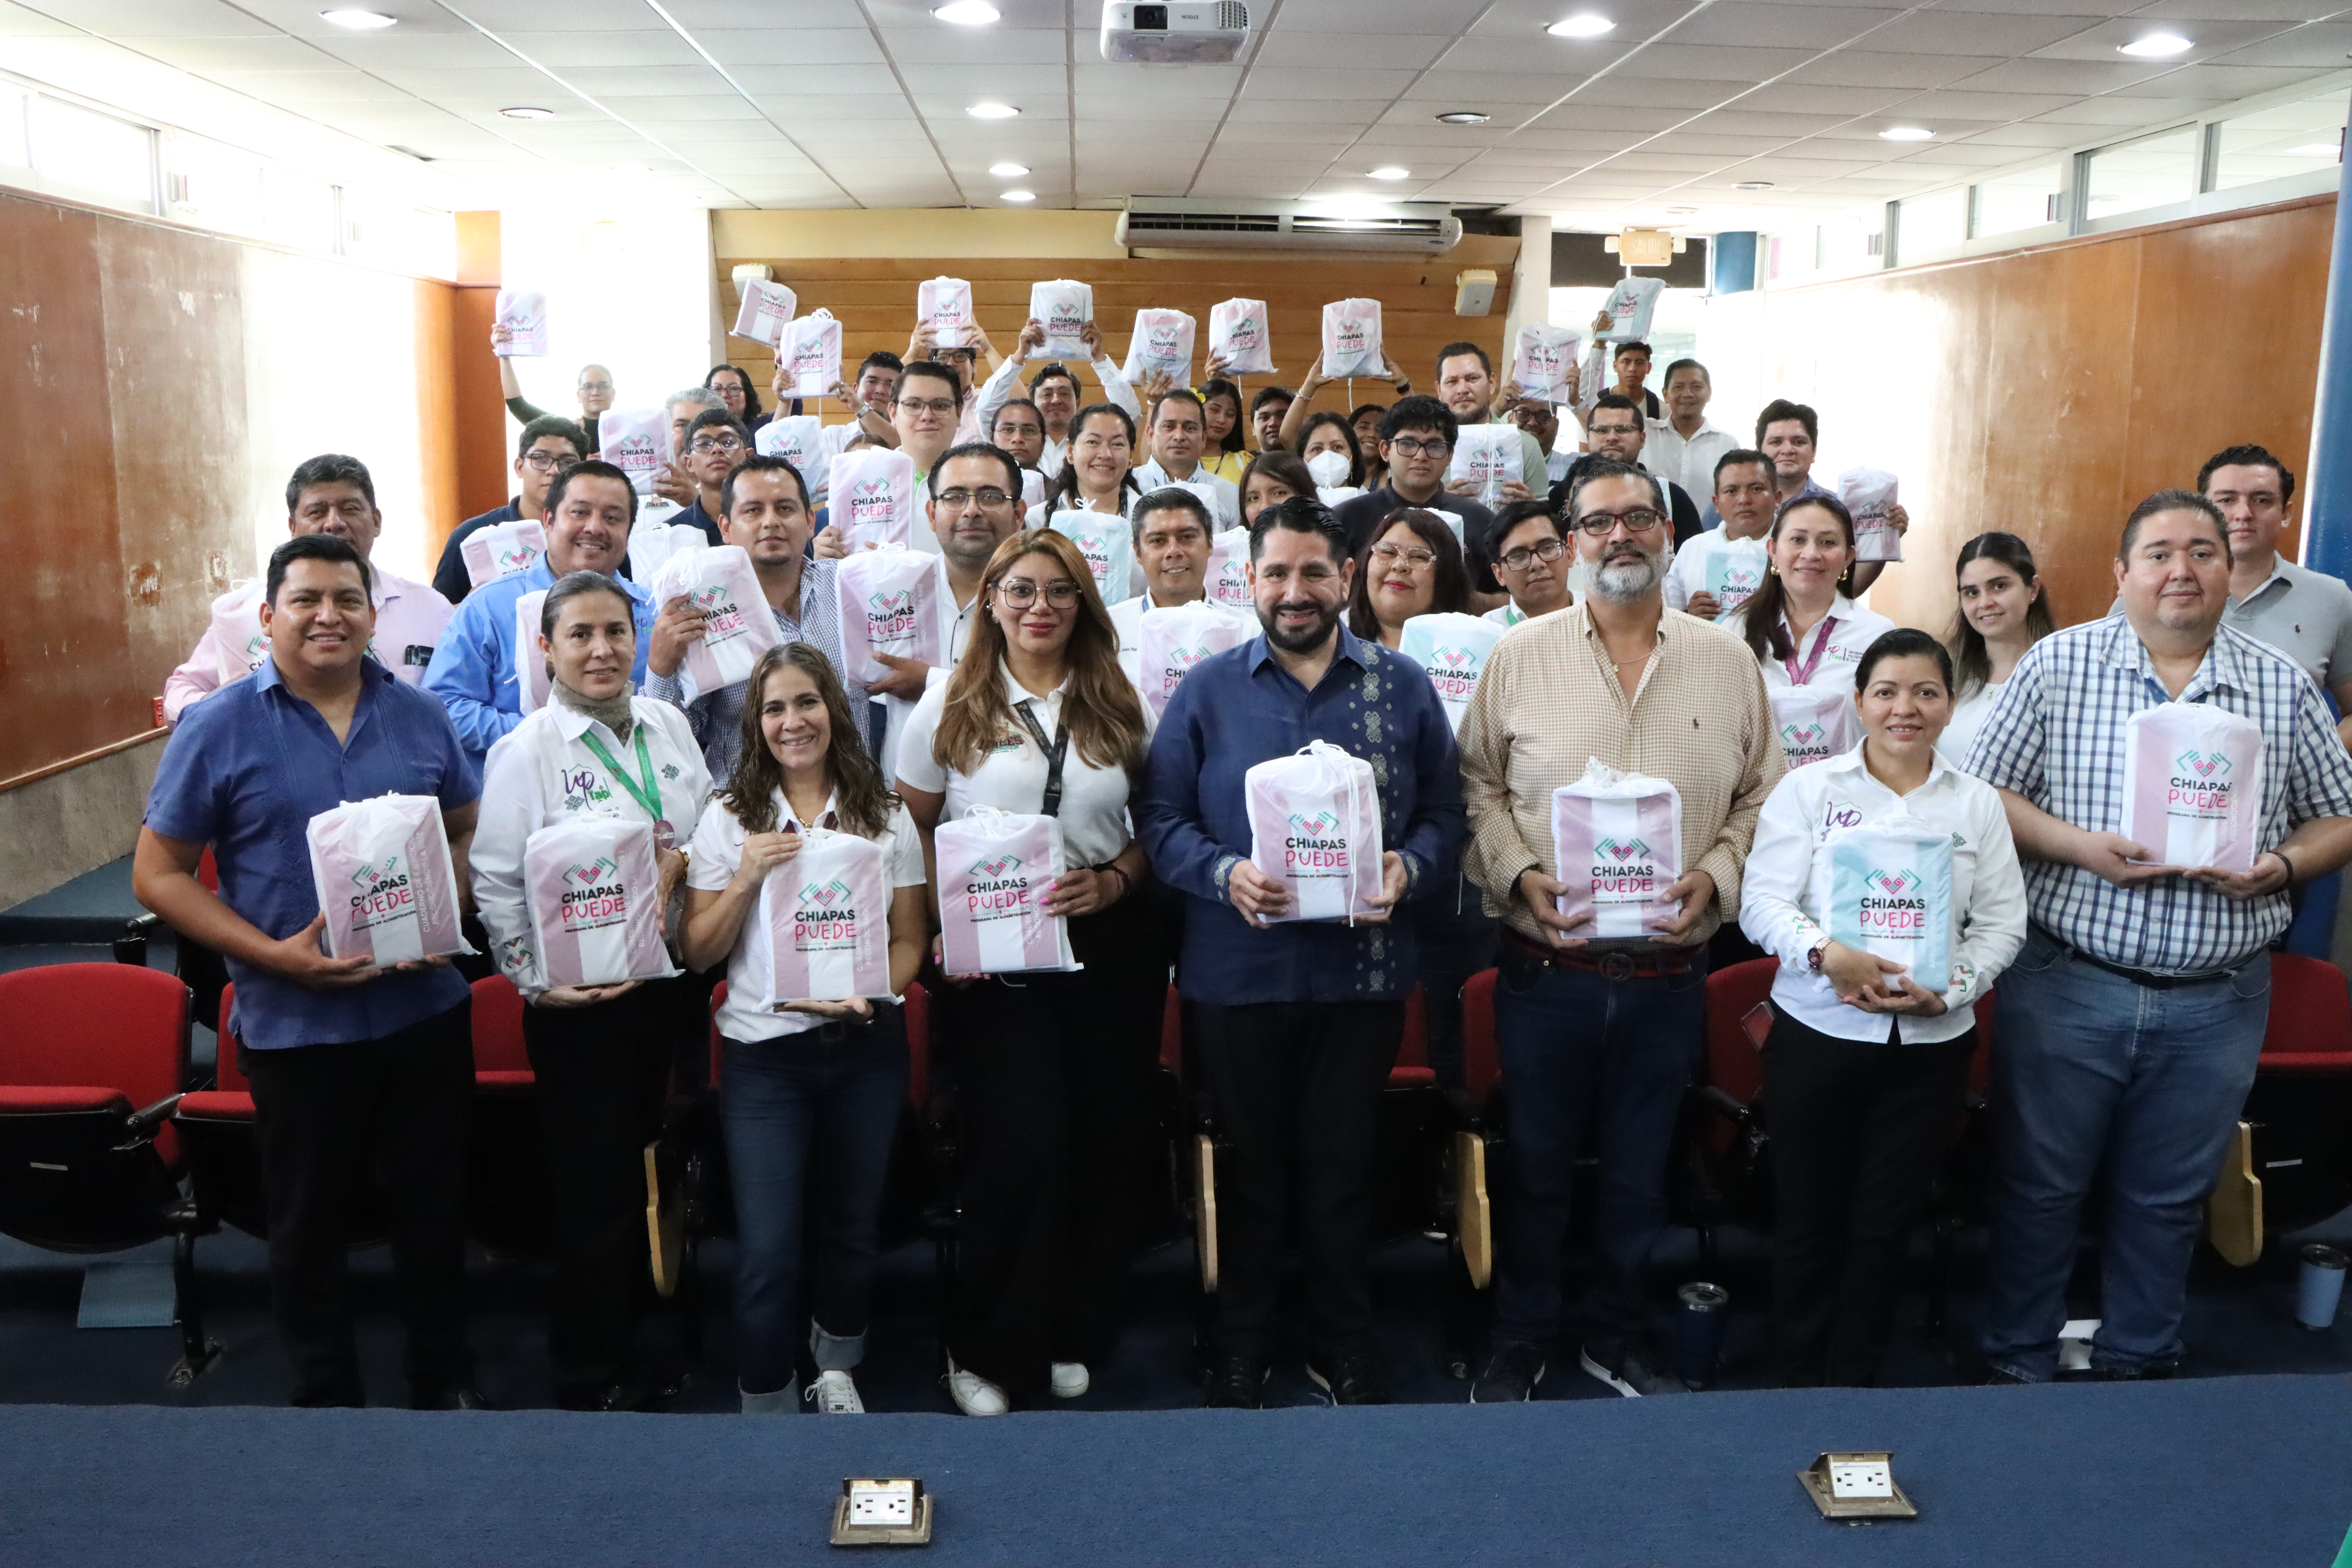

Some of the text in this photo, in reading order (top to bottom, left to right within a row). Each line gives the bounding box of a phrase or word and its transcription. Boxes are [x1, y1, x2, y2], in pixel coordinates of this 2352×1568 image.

[760, 302, 784, 315] PUEDE
[1050, 323, 1081, 332] PUEDE
[1228, 336, 1255, 346] PUEDE
[1230, 330, 1254, 340] HIAPAS
[1151, 339, 1177, 347] CHIAPAS
[1337, 339, 1365, 349] PUEDE
[1148, 344, 1177, 356] PUEDE
[794, 360, 824, 369] PUEDE
[770, 448, 802, 457] CHIAPAS
[621, 456, 656, 466] PUEDE
[852, 496, 893, 506] CHIAPAS
[852, 505, 893, 518] PUEDE
[1856, 519, 1883, 530] PUEDE
[702, 603, 738, 622] HIAPAS
[867, 606, 914, 622] CHIAPAS
[707, 613, 744, 633] UEDE
[867, 617, 916, 635] PUEDE
[1426, 667, 1477, 681] CHIAPAS
[1435, 679, 1475, 694] UEDE
[2170, 777, 2232, 792] CHIAPAS
[588, 789, 610, 801] Tap
[2168, 789, 2227, 809] PUEDE
[1285, 837, 1347, 850] CHIAPAS
[1285, 850, 1349, 868] PUEDE
[1592, 865, 1654, 877] CHIAPAS
[350, 874, 408, 907] CAPAS
[967, 877, 1028, 894] CHIAPAS
[1591, 878, 1654, 894] PUEDE
[562, 883, 624, 904] CHIAPAS
[968, 890, 1030, 913] PUEDE
[1861, 898, 1925, 909] CHIAPAS
[562, 897, 627, 923] PUEDE
[795, 909, 855, 922] CHIAPAS
[1860, 910, 1926, 928] PUEDE
[795, 923, 857, 941] PUEDE
